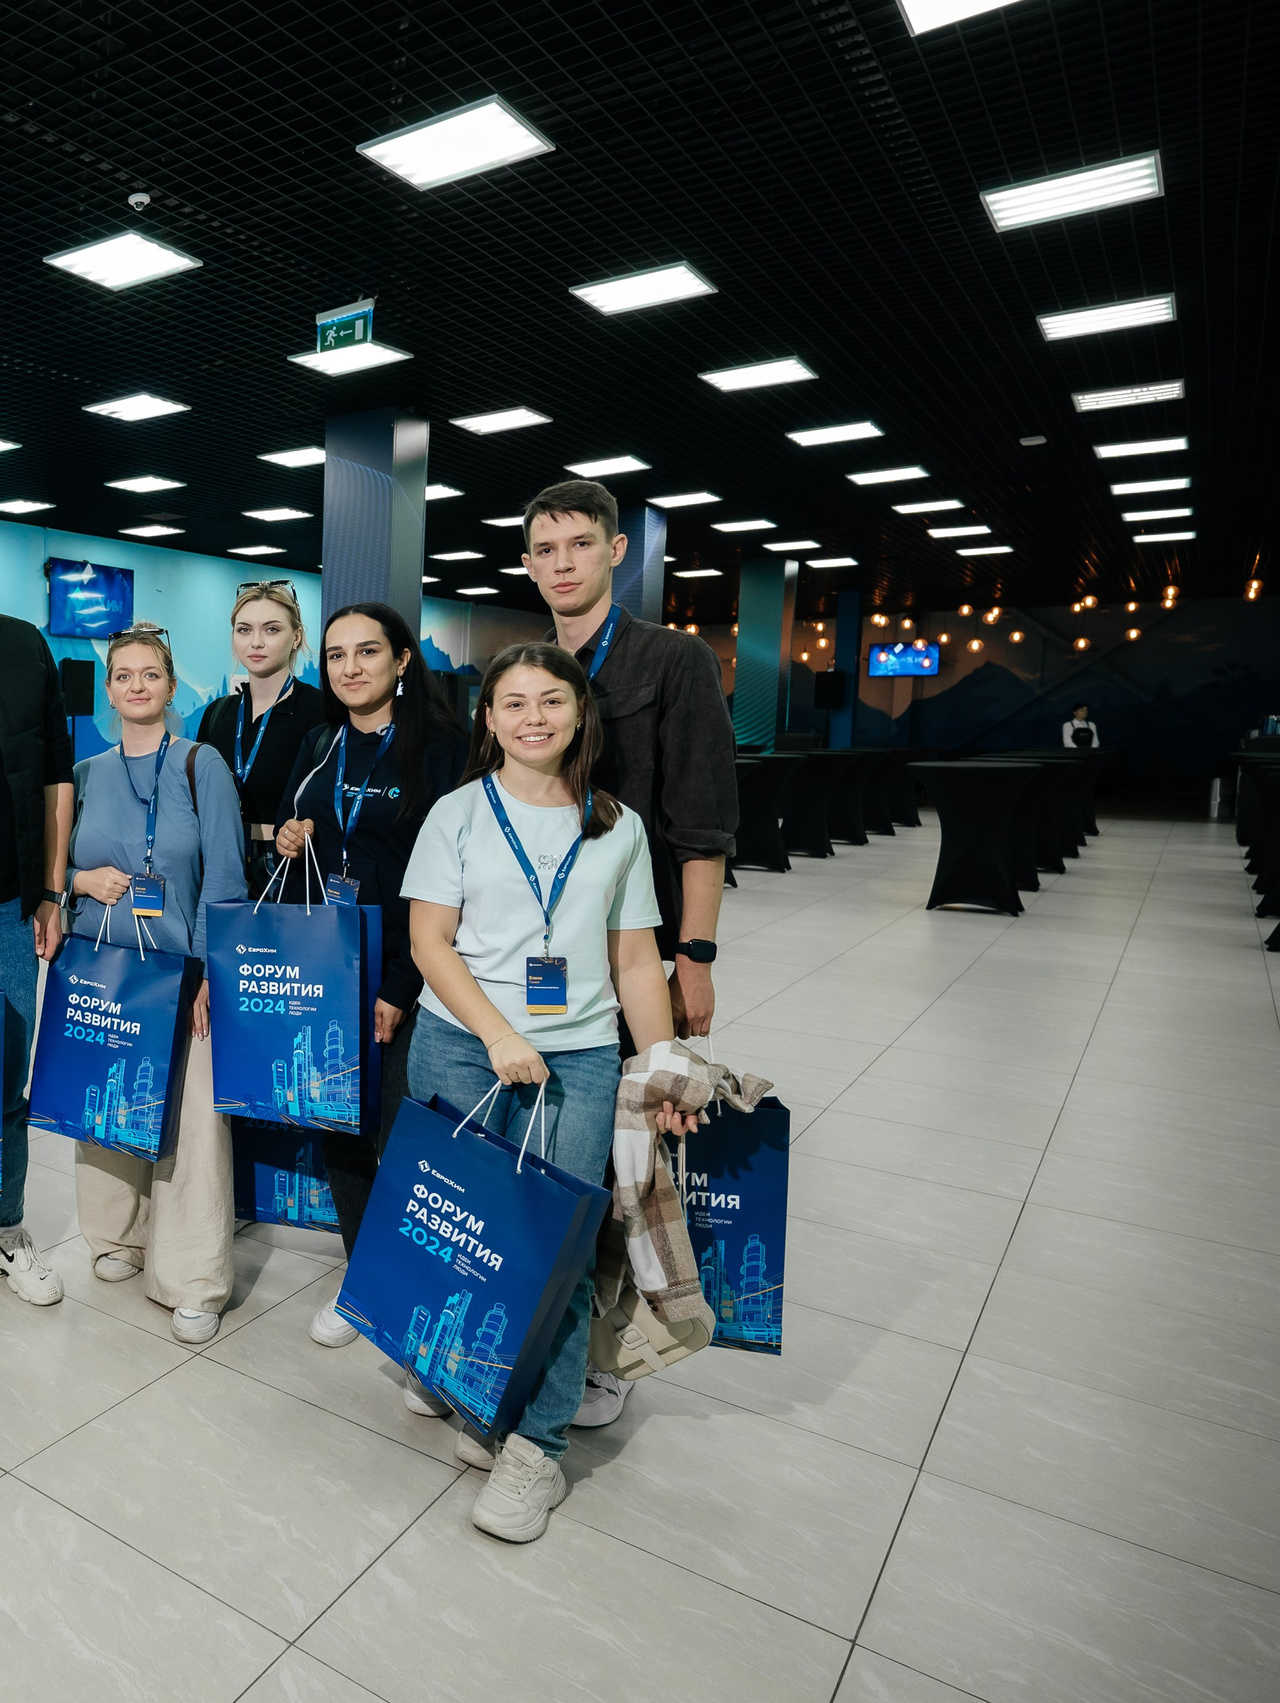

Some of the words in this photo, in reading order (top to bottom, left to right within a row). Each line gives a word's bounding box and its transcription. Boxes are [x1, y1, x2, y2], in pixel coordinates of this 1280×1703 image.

[239, 963, 299, 979] ФОРУМ
[239, 980, 323, 998] РАЗВИТИЯ
[68, 993, 122, 1015] ФОРУМ
[239, 997, 286, 1014] 2024
[66, 1008, 140, 1035] РАЗВИТИЯ
[64, 1023, 105, 1045] 2024
[413, 1184, 485, 1236] ФОРУМ
[399, 1218, 453, 1264] 2024
[406, 1199, 503, 1272] РАЗВИТИЯ
[457, 1253, 471, 1264] ИДЕИ
[453, 1264, 468, 1276] ЛЮДИ
[455, 1258, 486, 1282] ТЕХНОЛОГИИ
